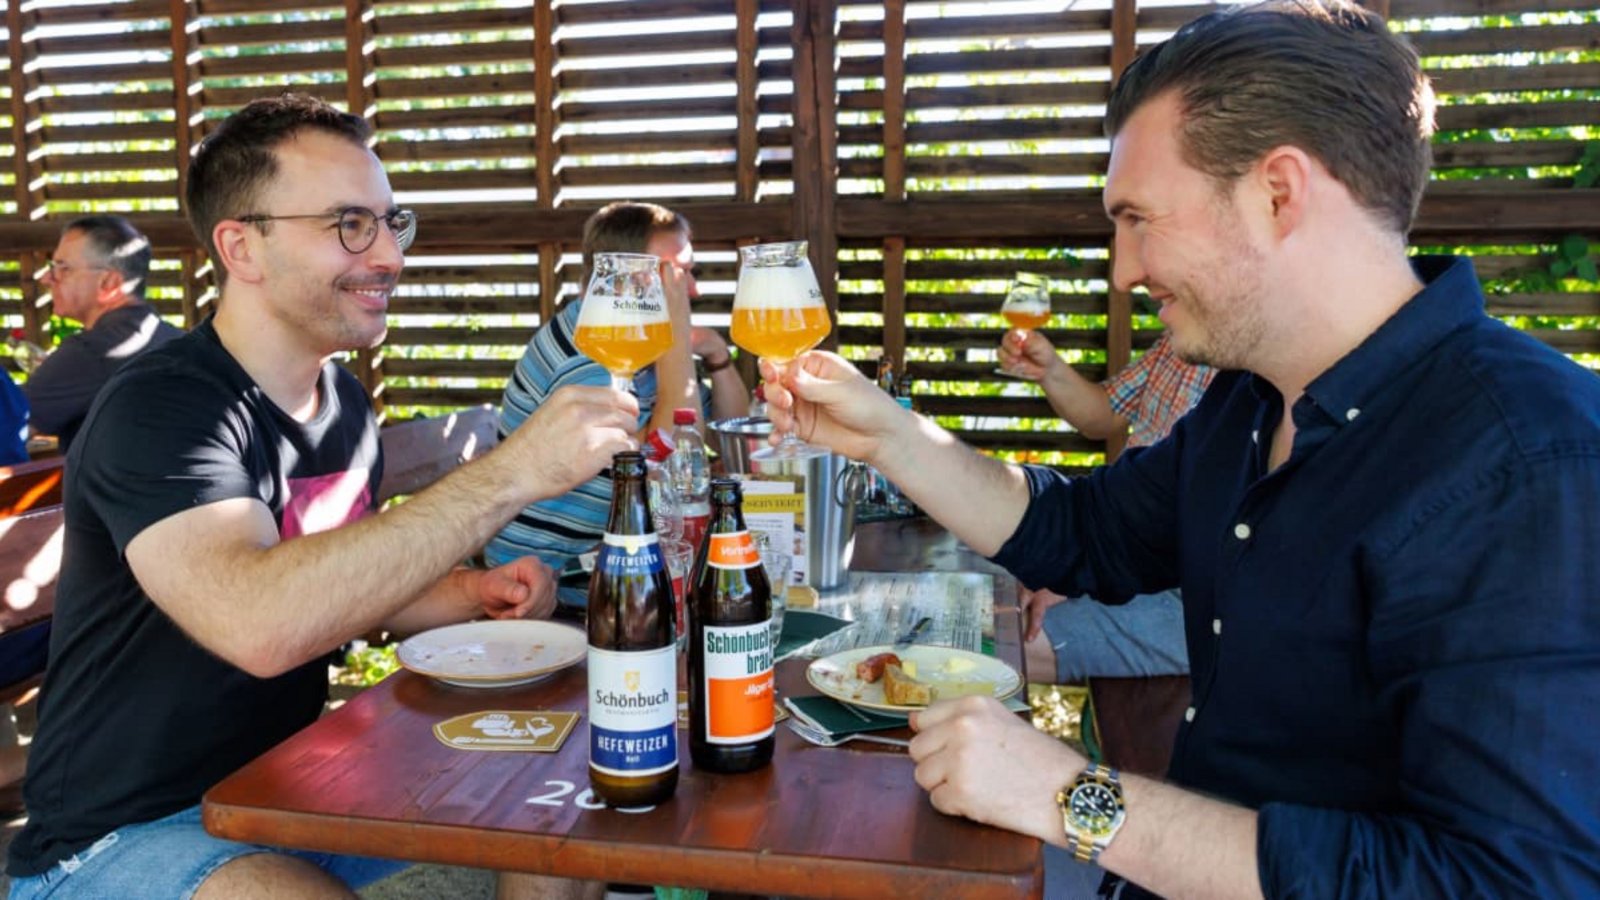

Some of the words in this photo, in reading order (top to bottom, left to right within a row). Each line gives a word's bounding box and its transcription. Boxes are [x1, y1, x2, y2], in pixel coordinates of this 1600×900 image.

[612, 299, 662, 312] Schönbuch
[595, 688, 669, 708] Schönbuch
[597, 734, 669, 753] HEFEWEIZEN
